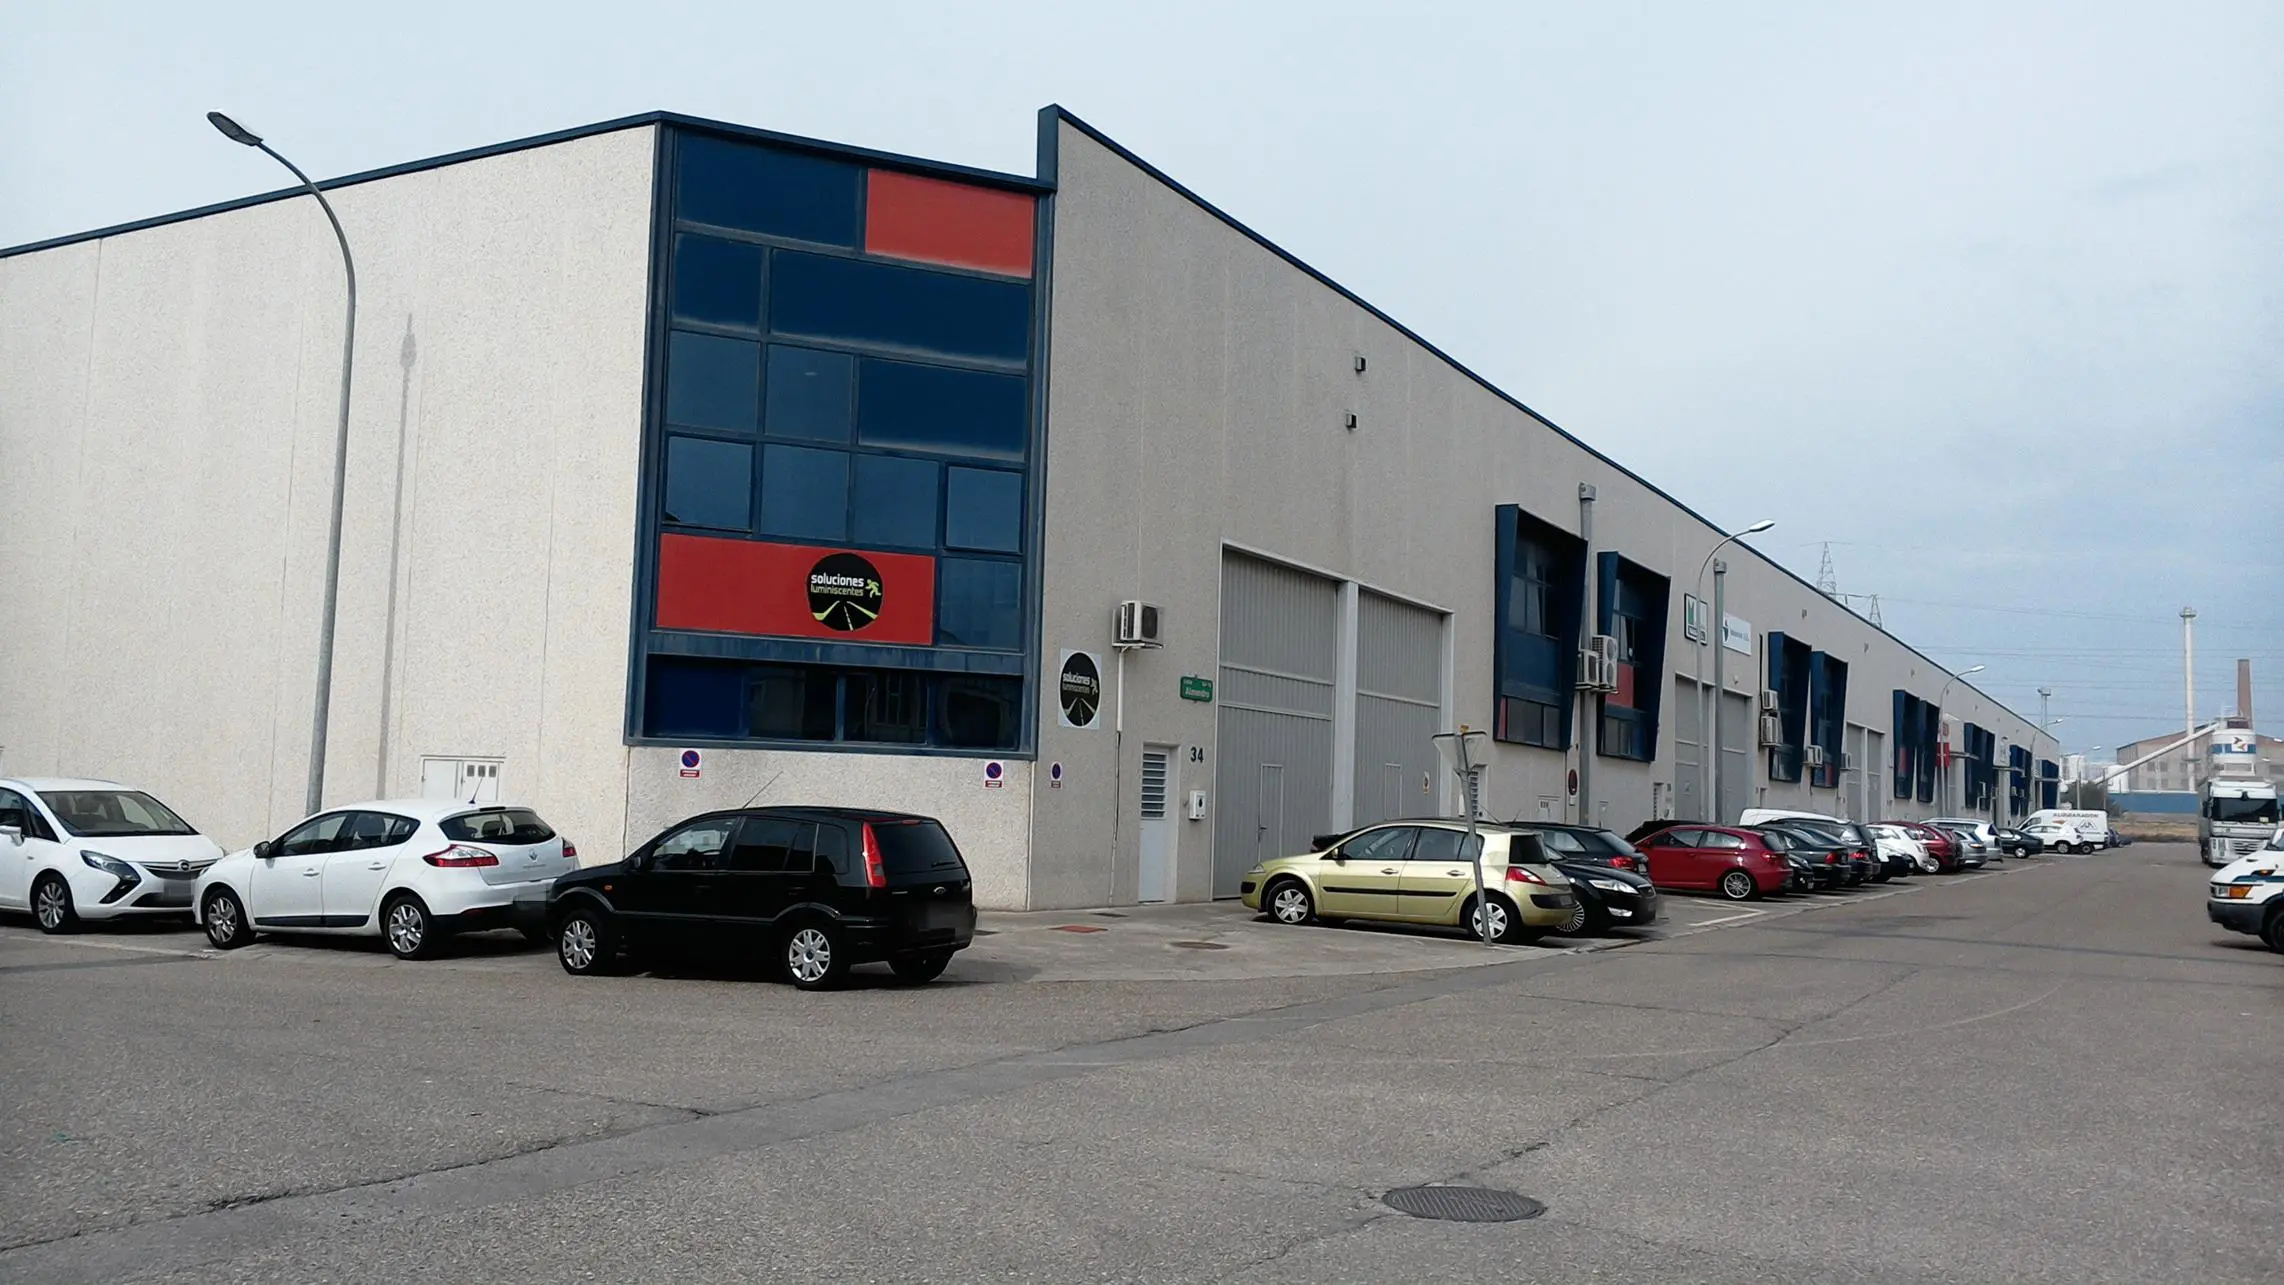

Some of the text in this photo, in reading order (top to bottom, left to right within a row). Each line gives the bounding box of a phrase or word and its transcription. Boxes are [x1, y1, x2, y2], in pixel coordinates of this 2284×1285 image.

[811, 572, 864, 587] soluciones
[811, 584, 864, 597] luminiscentes
[1190, 746, 1204, 764] 34
